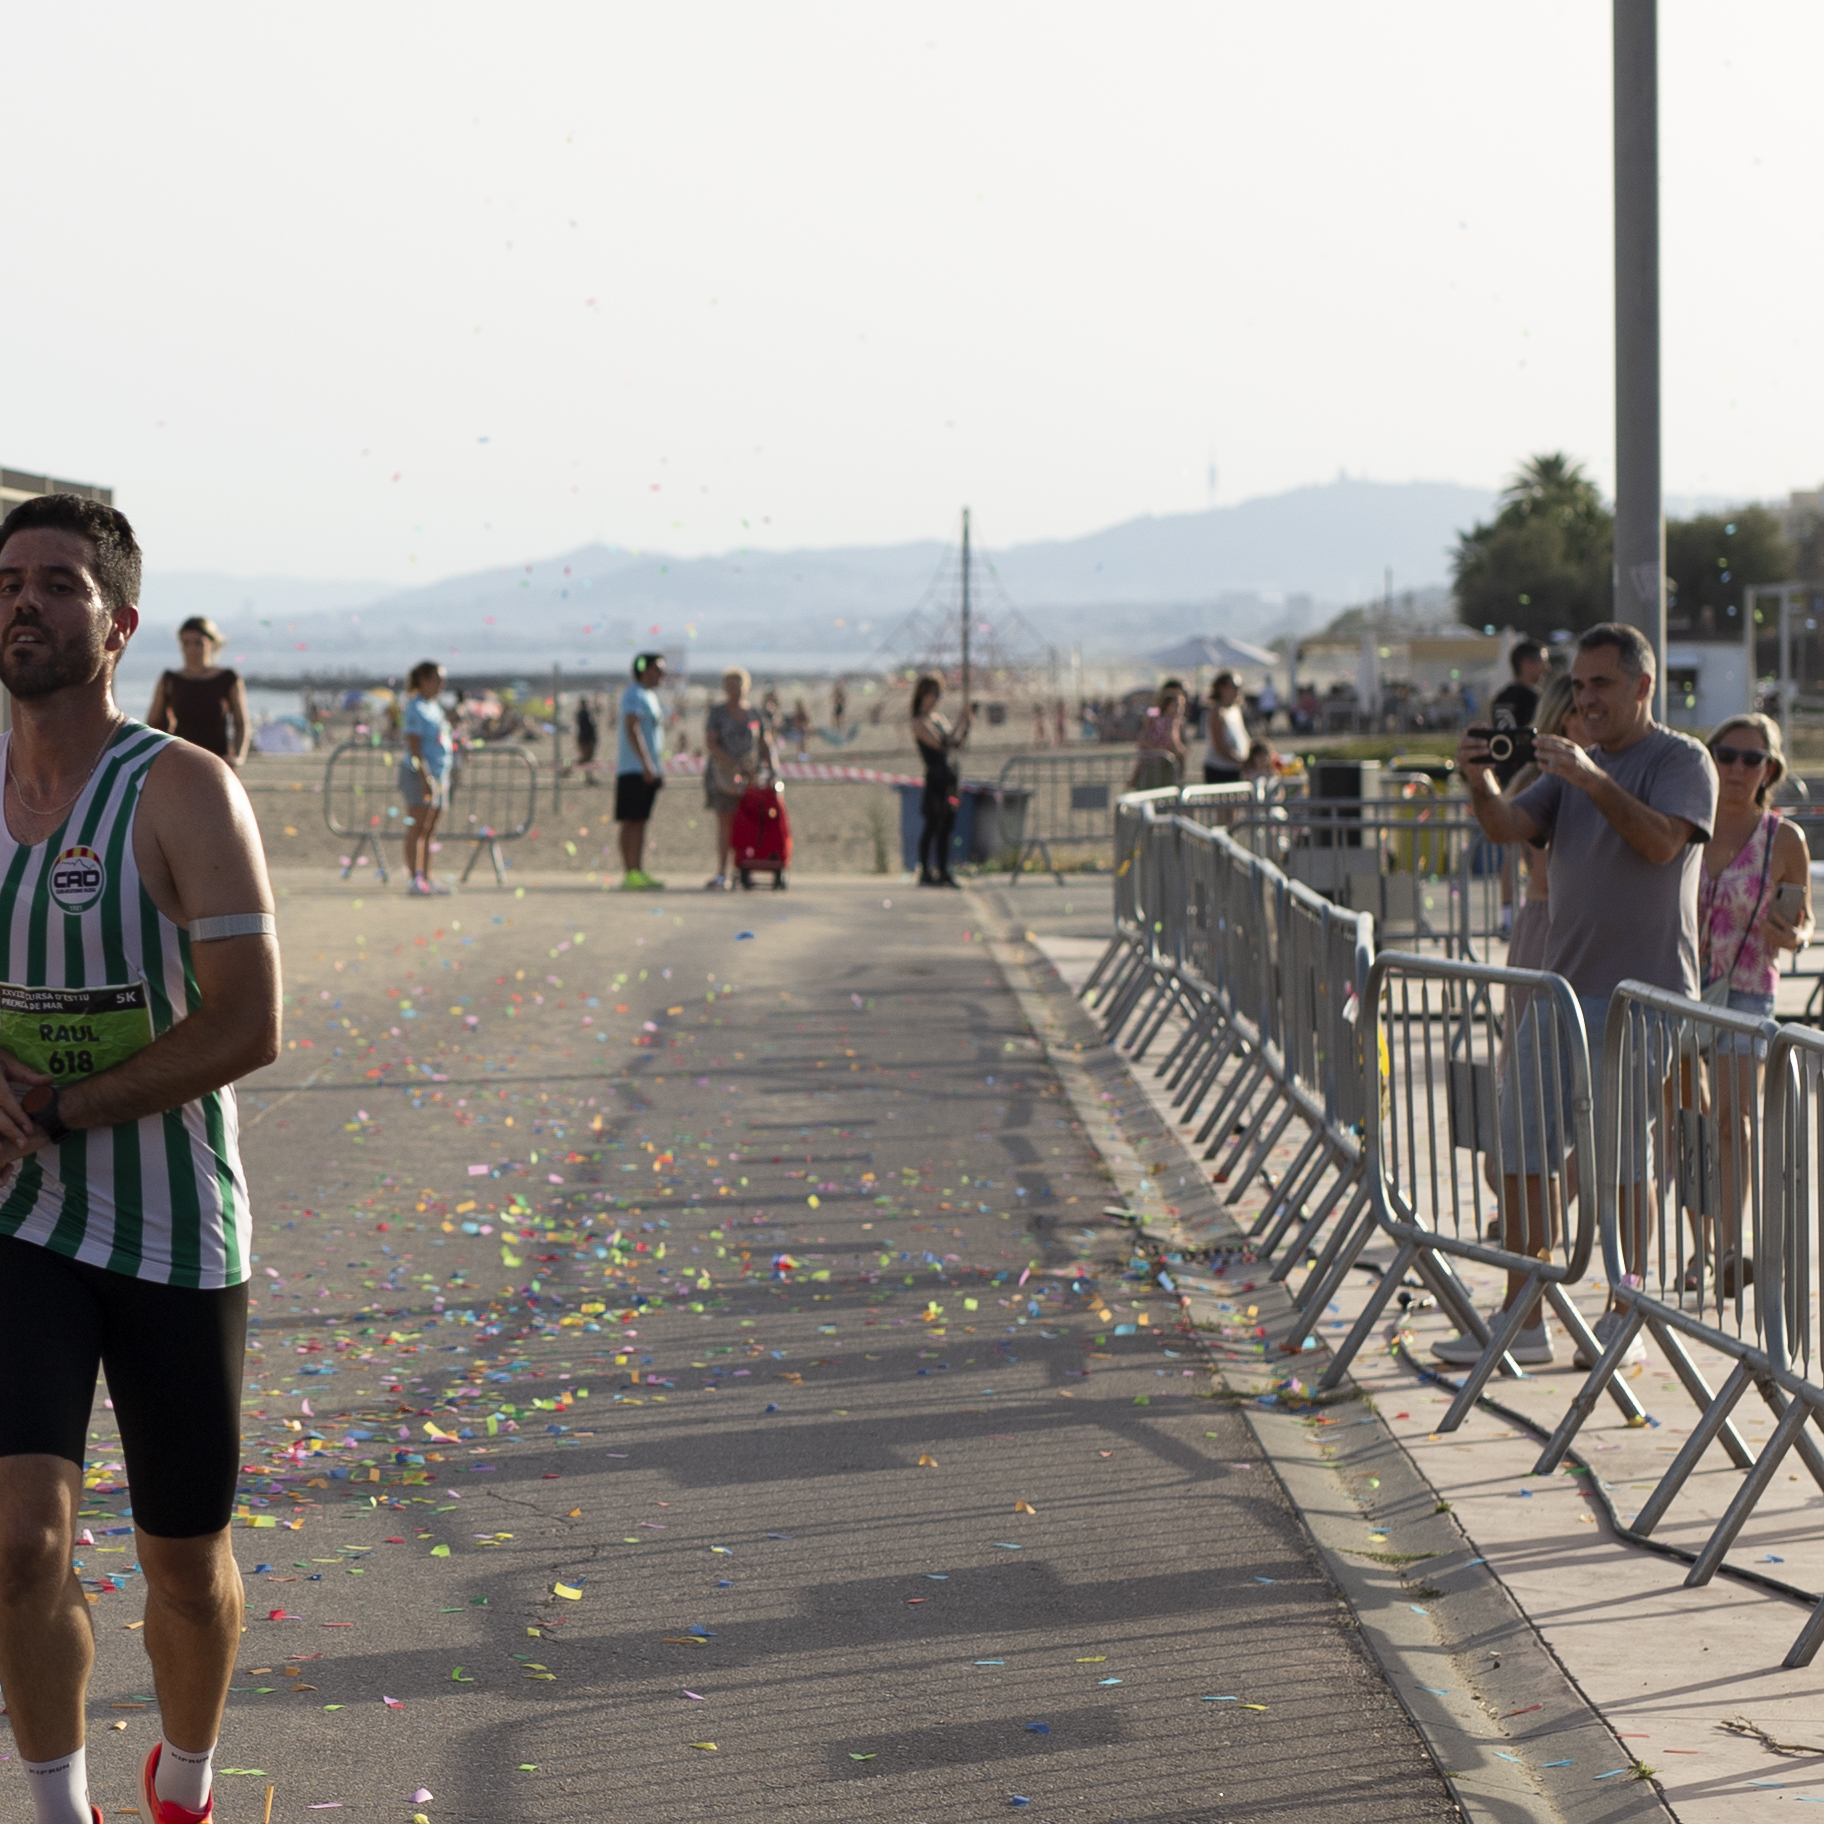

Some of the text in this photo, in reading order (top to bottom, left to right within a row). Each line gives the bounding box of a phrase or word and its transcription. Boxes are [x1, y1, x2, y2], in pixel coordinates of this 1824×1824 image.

[29, 1002, 41, 1010] DE
[43, 1001, 64, 1010] MAR
[116, 991, 138, 1005] 5K
[39, 1024, 101, 1043] RAUL
[49, 1050, 94, 1074] 618
